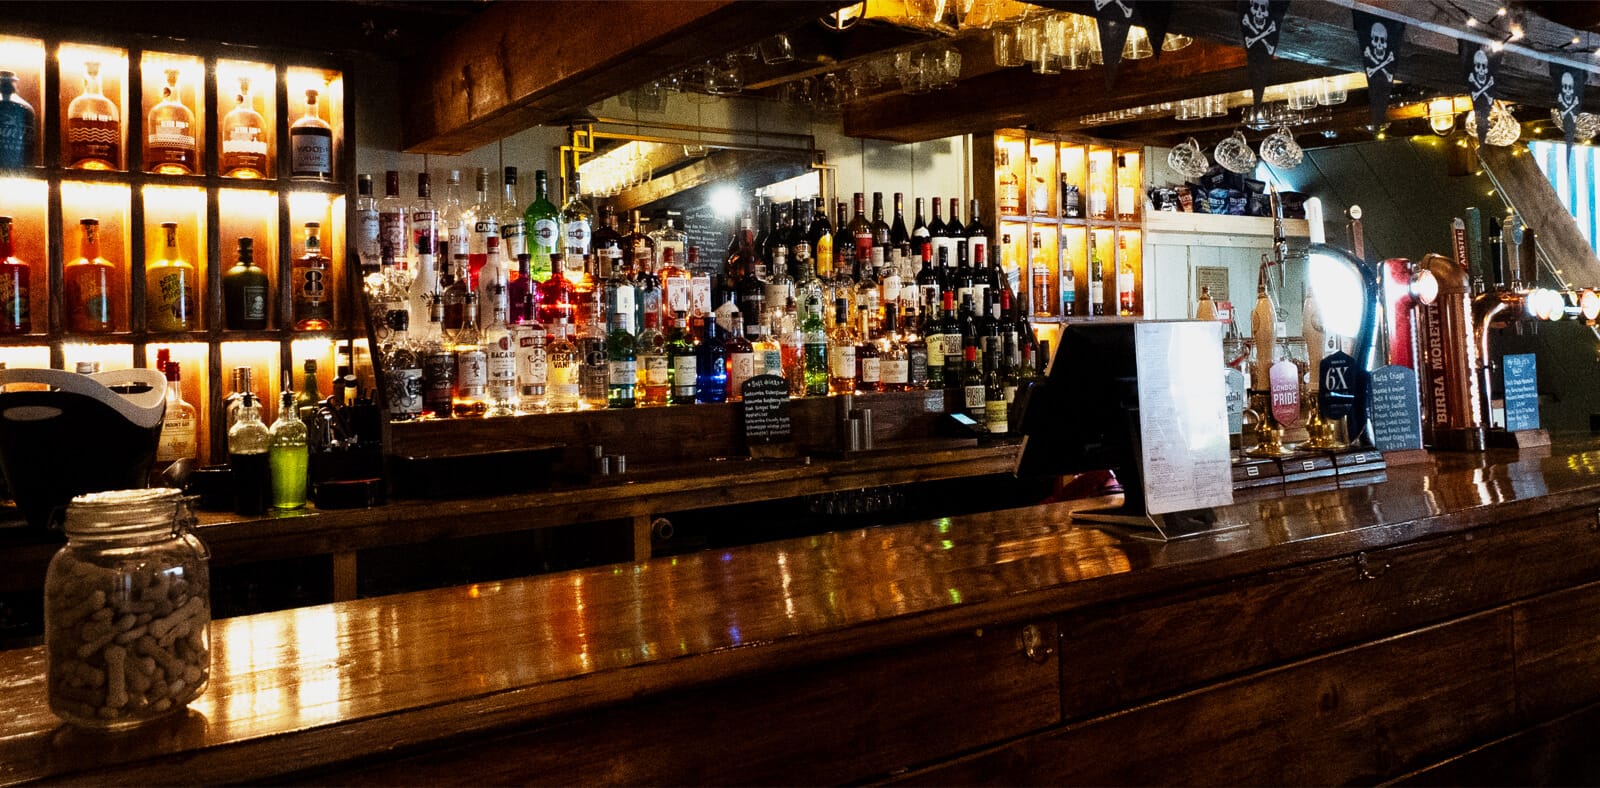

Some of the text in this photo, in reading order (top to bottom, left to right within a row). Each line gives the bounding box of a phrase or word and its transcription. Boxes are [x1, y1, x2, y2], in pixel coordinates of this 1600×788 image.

[1457, 230, 1466, 266] AMSTEL
[1428, 301, 1448, 423] BIRRA MORETTI
[1272, 383, 1297, 392] LONDON
[1325, 366, 1349, 391] 6X
[1273, 391, 1297, 407] PRIDE
